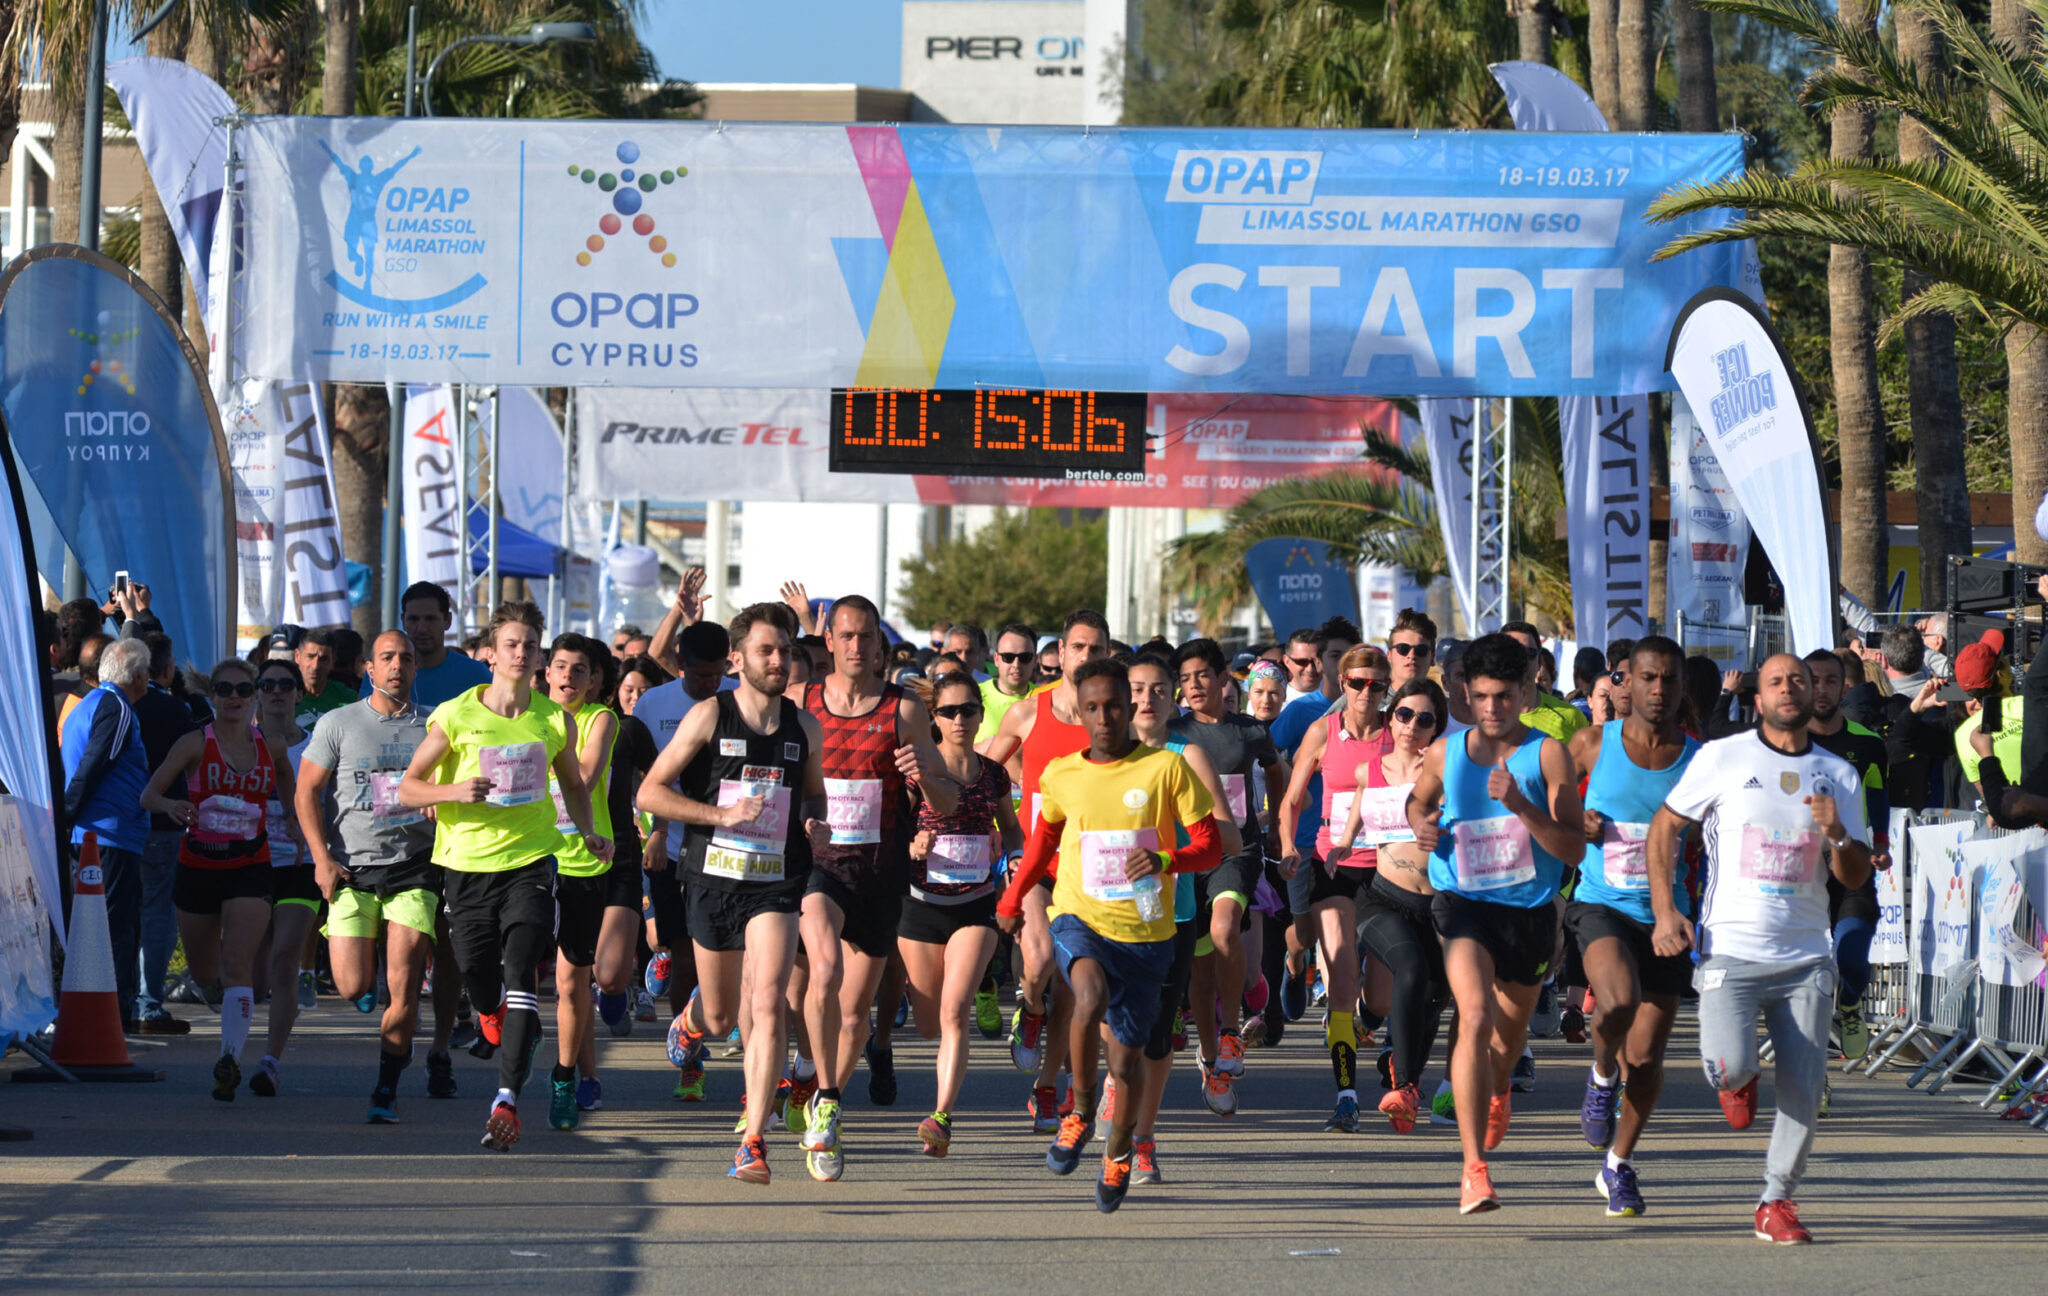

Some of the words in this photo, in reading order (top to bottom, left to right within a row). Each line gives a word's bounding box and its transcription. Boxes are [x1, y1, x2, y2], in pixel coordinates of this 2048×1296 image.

[927, 37, 1022, 60] PIER
[1182, 157, 1311, 195] OPAP
[1499, 167, 1629, 188] 18-19.03.17
[385, 187, 470, 213] OPAP
[385, 218, 477, 234] LIMASSOL
[1242, 210, 1372, 231] LIMASSOL
[1380, 211, 1521, 233] MARATHON
[1530, 213, 1581, 233] GSO
[385, 238, 485, 254] MARATHON
[385, 257, 418, 273] GSO
[322, 313, 361, 328] RUN
[366, 313, 412, 328] WITH
[412, 314, 427, 329] A
[433, 315, 489, 330] SMILE
[1165, 263, 1624, 378] START
[348, 343, 459, 361] 18-19.03.17
[551, 342, 699, 367] CYPRUS
[1191, 422, 1245, 439] OPAP
[1065, 468, 1144, 482] bertele.com
[1182, 475, 1208, 488] SEE
[492, 764, 537, 787] 3152
[744, 767, 782, 780] HIGH5
[707, 849, 747, 872] BIKE
[749, 855, 783, 875] HUB
[1466, 840, 1520, 868] 3446
